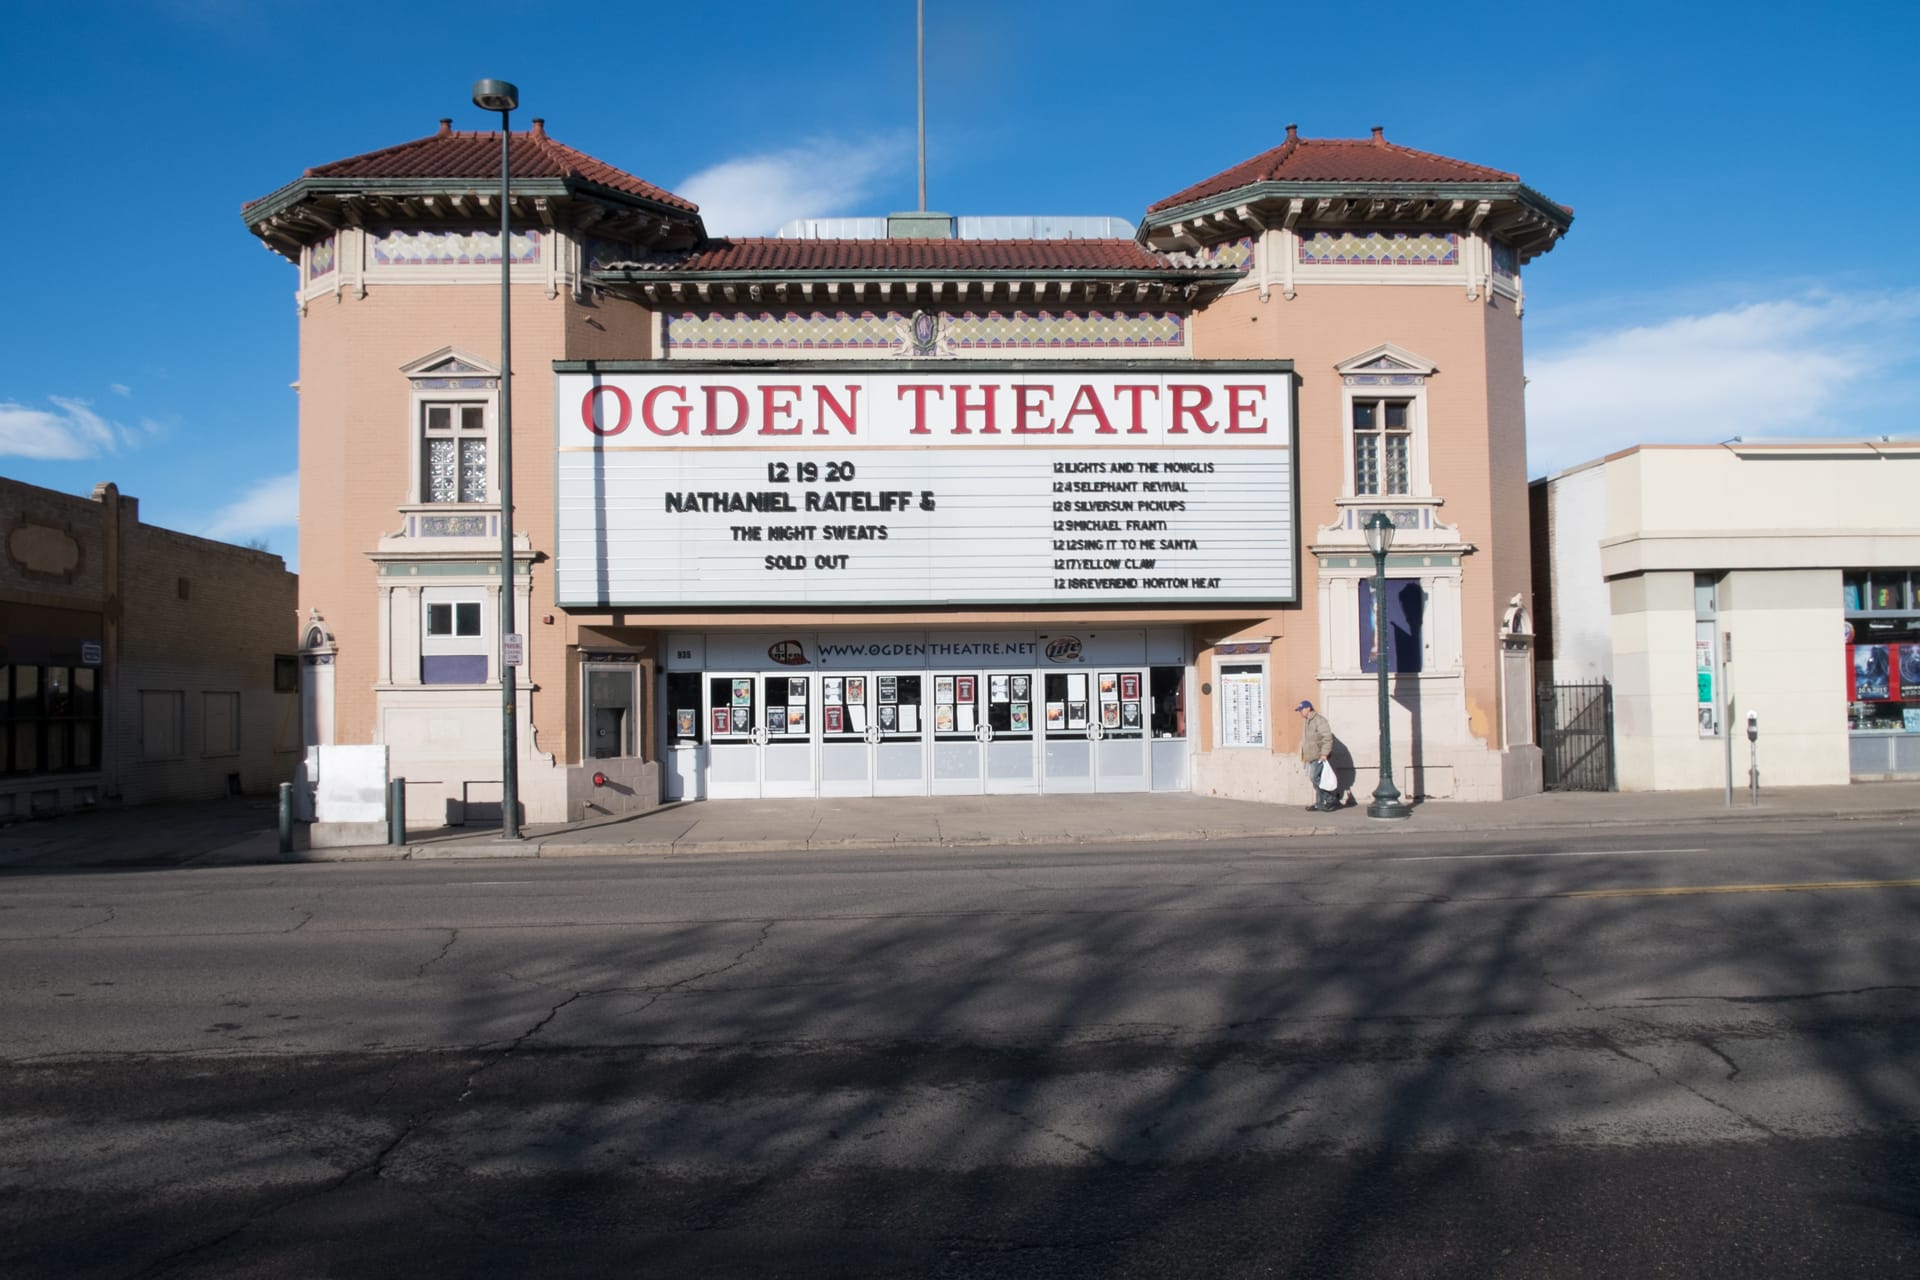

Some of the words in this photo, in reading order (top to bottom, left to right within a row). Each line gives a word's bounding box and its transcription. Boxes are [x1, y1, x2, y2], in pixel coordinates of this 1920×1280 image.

[581, 384, 862, 436] OGDEN
[897, 384, 1269, 435] THEATRE
[768, 462, 790, 483] 12
[797, 462, 818, 483] 19
[825, 462, 855, 482] 20
[1110, 462, 1134, 473] AND
[1137, 462, 1159, 473] THE
[1164, 462, 1215, 473] MOWGLIS
[1143, 481, 1188, 492] REVIVAL
[665, 491, 797, 513] NATHANIEL
[806, 491, 913, 512] RATELIFF
[919, 491, 936, 512] &
[1074, 501, 1134, 512] SILVERSUN
[1138, 500, 1186, 512] PICKUPS
[1074, 520, 1122, 531] MICHAEL
[1126, 520, 1167, 531] FRANTI
[731, 526, 762, 541] THE
[768, 526, 817, 541] NIGHT
[823, 525, 888, 540] SWEATS
[1077, 539, 1104, 550] SING
[1107, 540, 1118, 550] IT
[1121, 539, 1137, 550] TO
[1140, 540, 1156, 550] ME
[1160, 539, 1198, 550] SANTA
[765, 555, 807, 570] SOLD
[814, 555, 849, 570] OUT
[1076, 559, 1121, 569] YELLOW
[1125, 559, 1156, 569] CLAW
[1079, 578, 1138, 589] REVEREND
[1143, 578, 1189, 589] HORTON
[1192, 577, 1222, 589] HEAT
